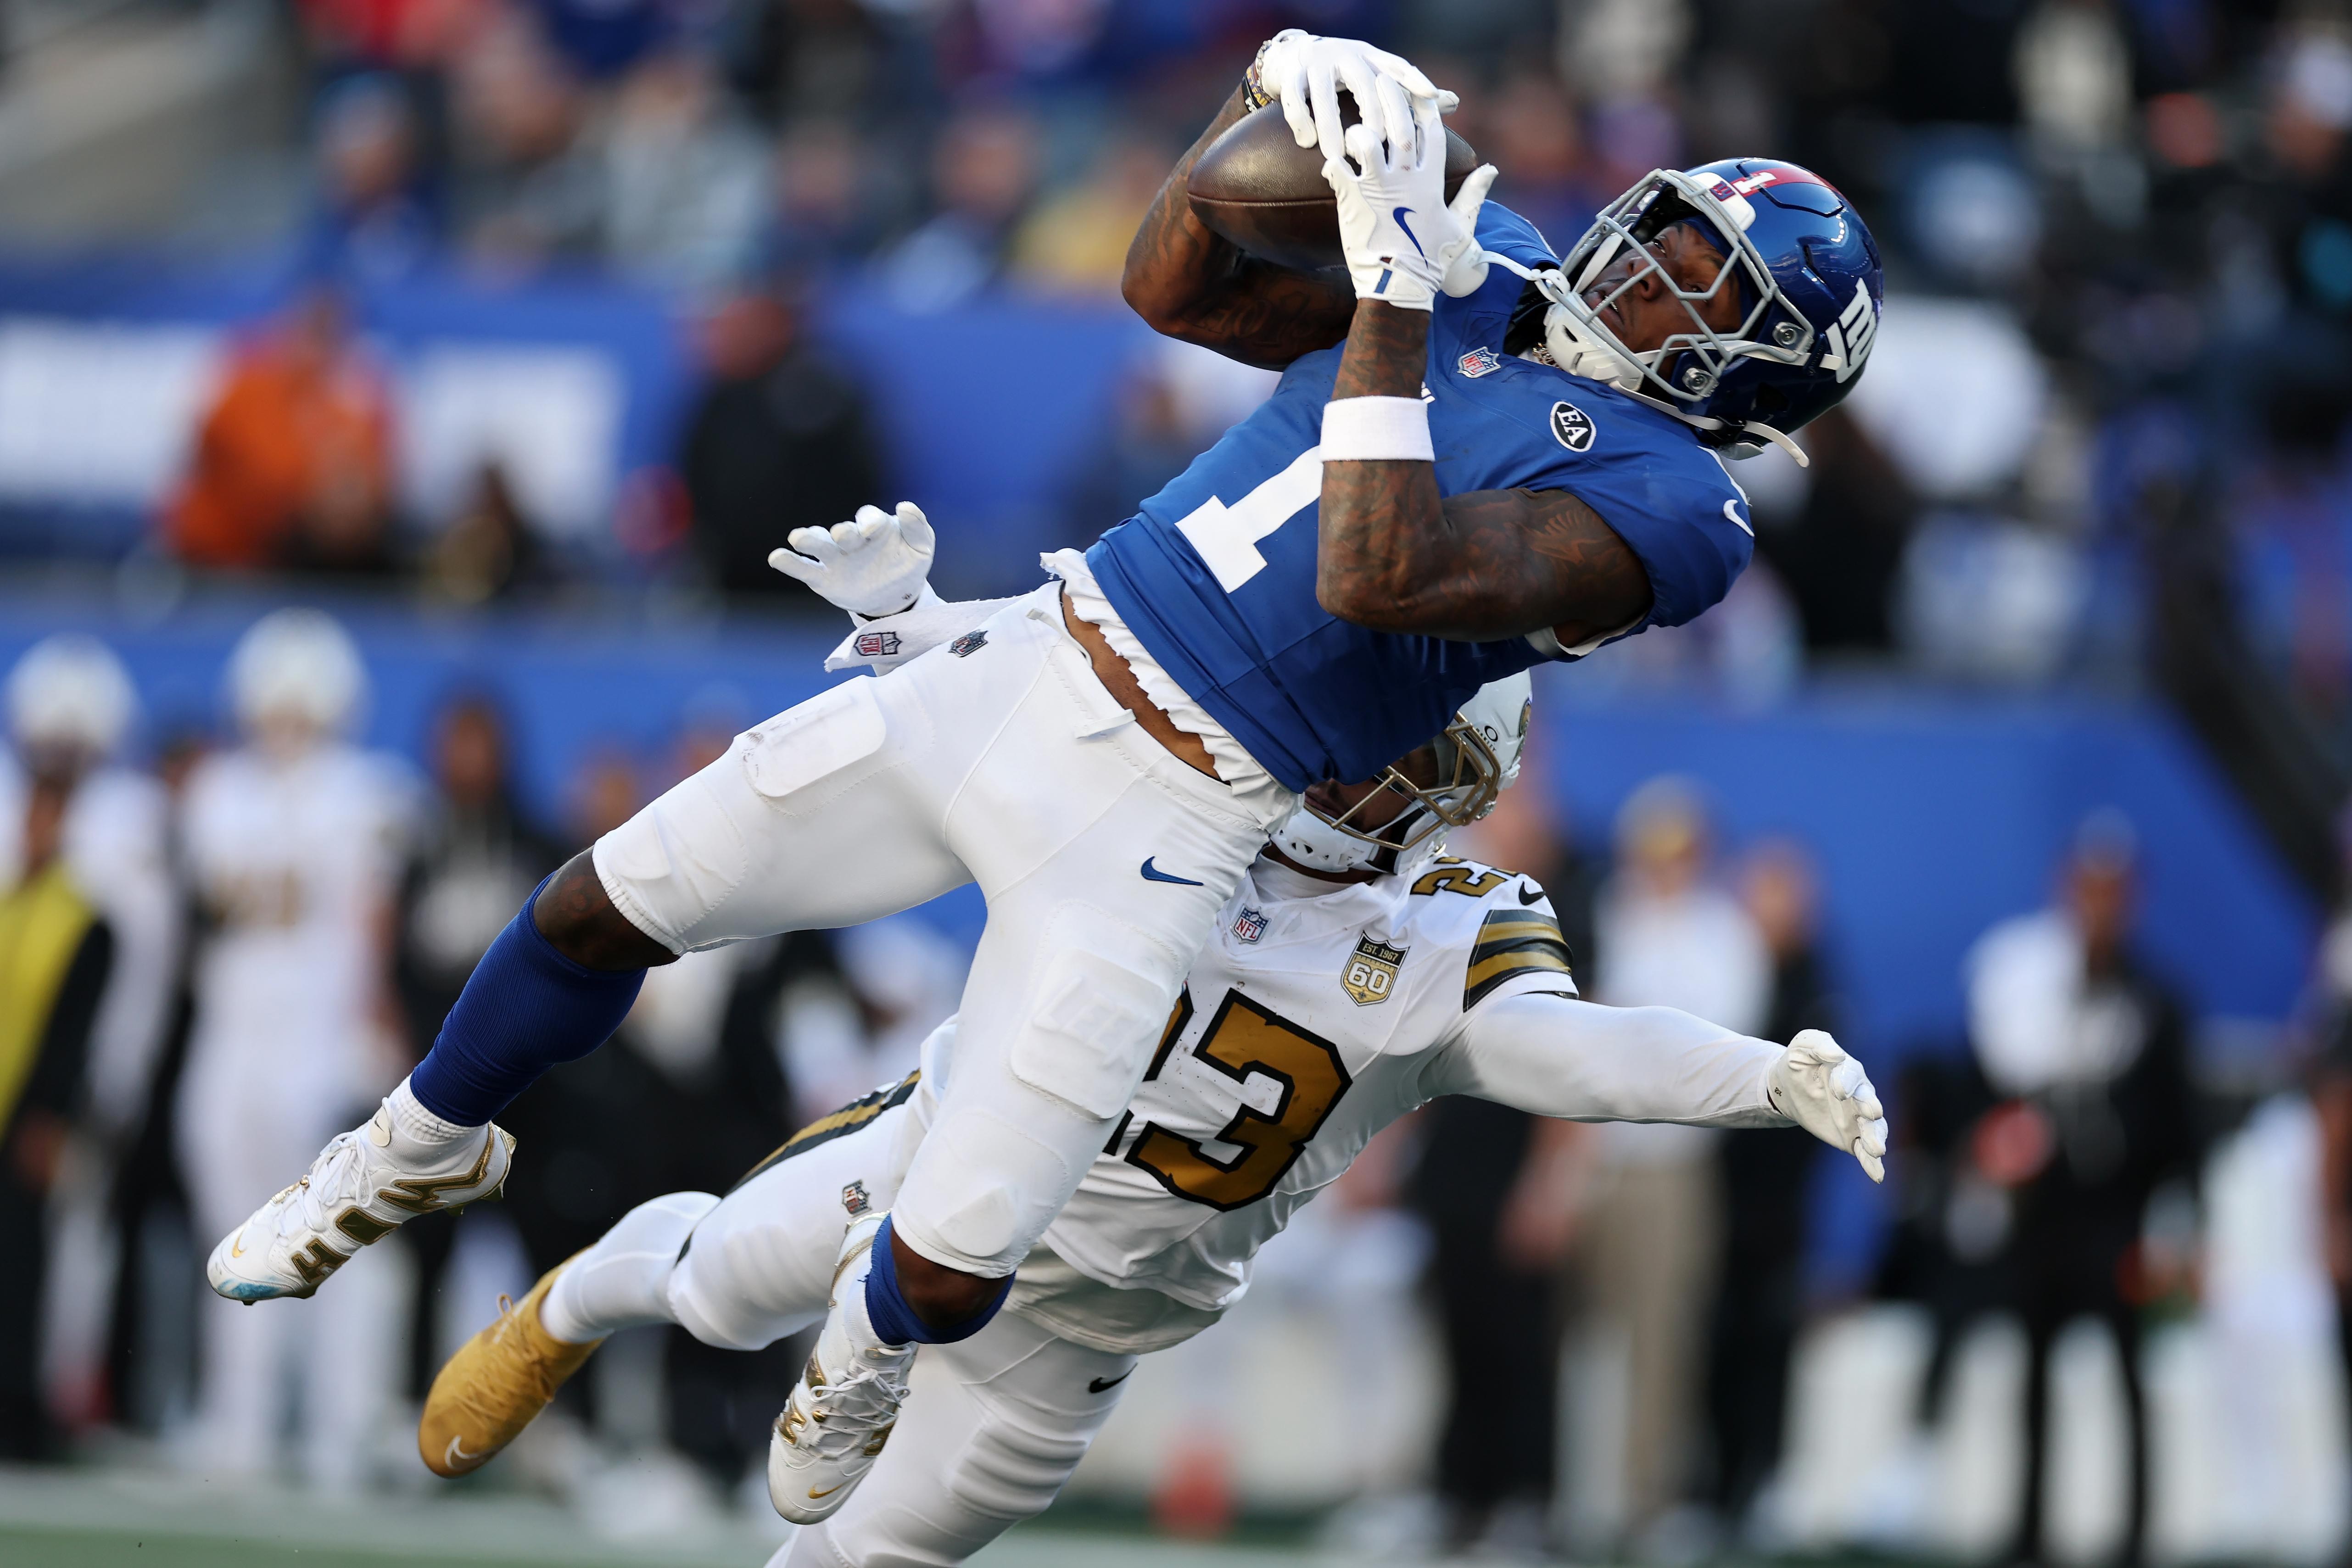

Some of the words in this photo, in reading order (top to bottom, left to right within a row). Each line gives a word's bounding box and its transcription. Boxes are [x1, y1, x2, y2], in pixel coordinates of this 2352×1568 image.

[1733, 172, 1777, 194] 1
[1463, 355, 1485, 374] NFL
[1556, 409, 1588, 445] EA
[1175, 445, 1323, 593] 1
[1410, 856, 1519, 898] 2
[1236, 918, 1258, 939] NFL
[1362, 943, 1379, 955] EST.
[1378, 948, 1399, 962] 1967
[1347, 961, 1391, 994] 60
[1102, 982, 1353, 1212] 3
